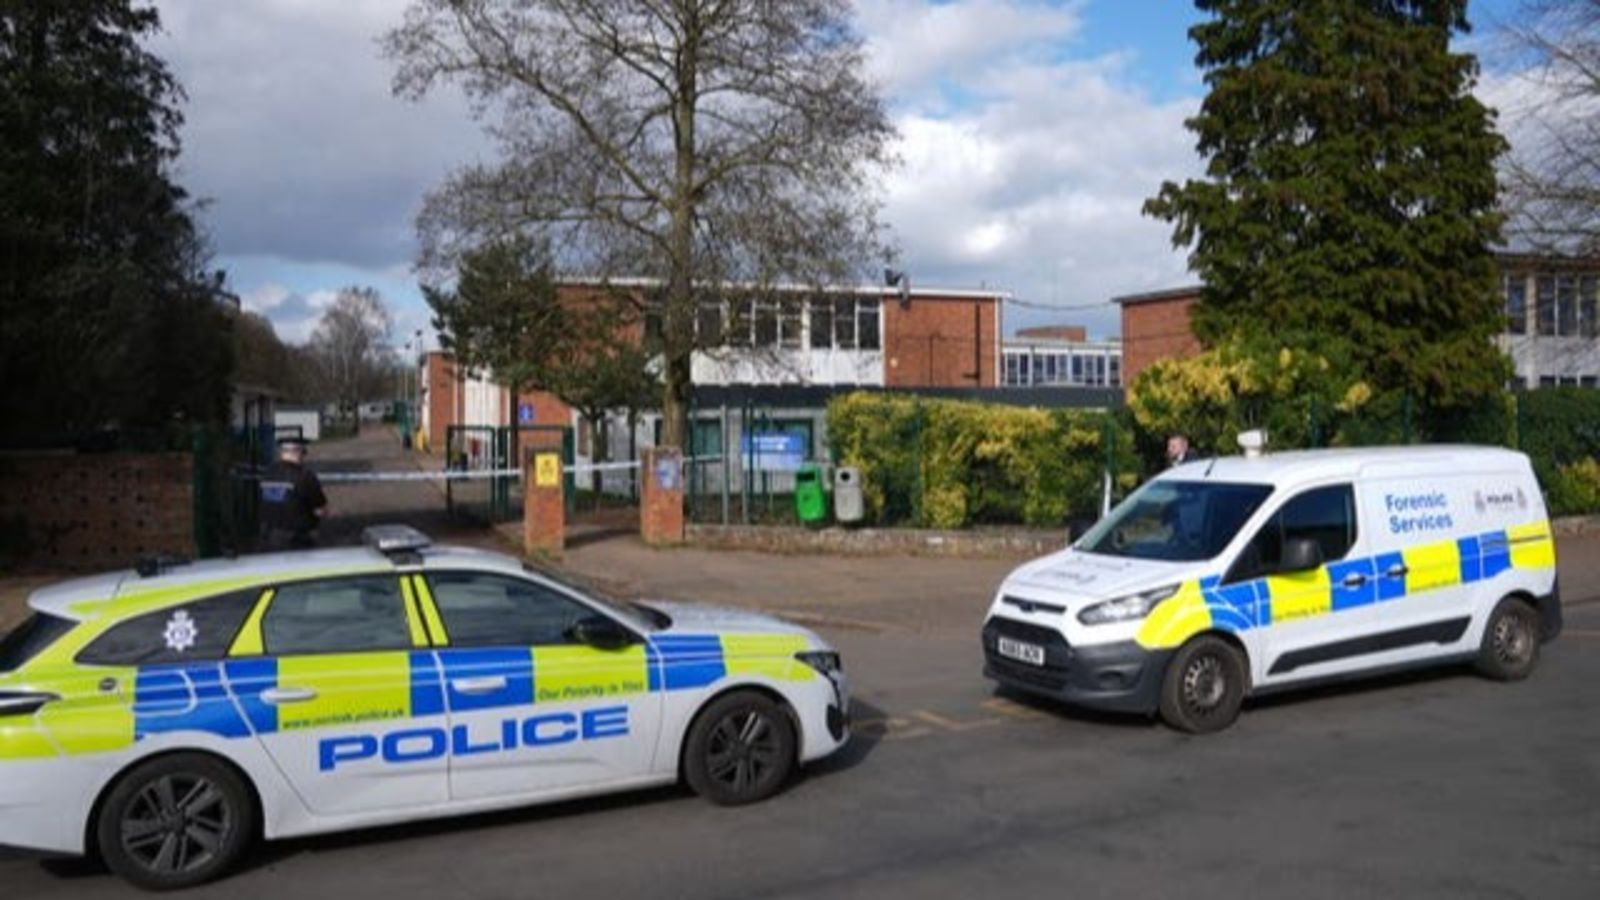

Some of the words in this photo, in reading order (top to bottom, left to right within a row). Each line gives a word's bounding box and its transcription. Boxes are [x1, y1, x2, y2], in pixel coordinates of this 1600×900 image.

[1385, 490, 1447, 511] Forensic
[1389, 513, 1453, 533] Services
[318, 705, 630, 772] POLICE
